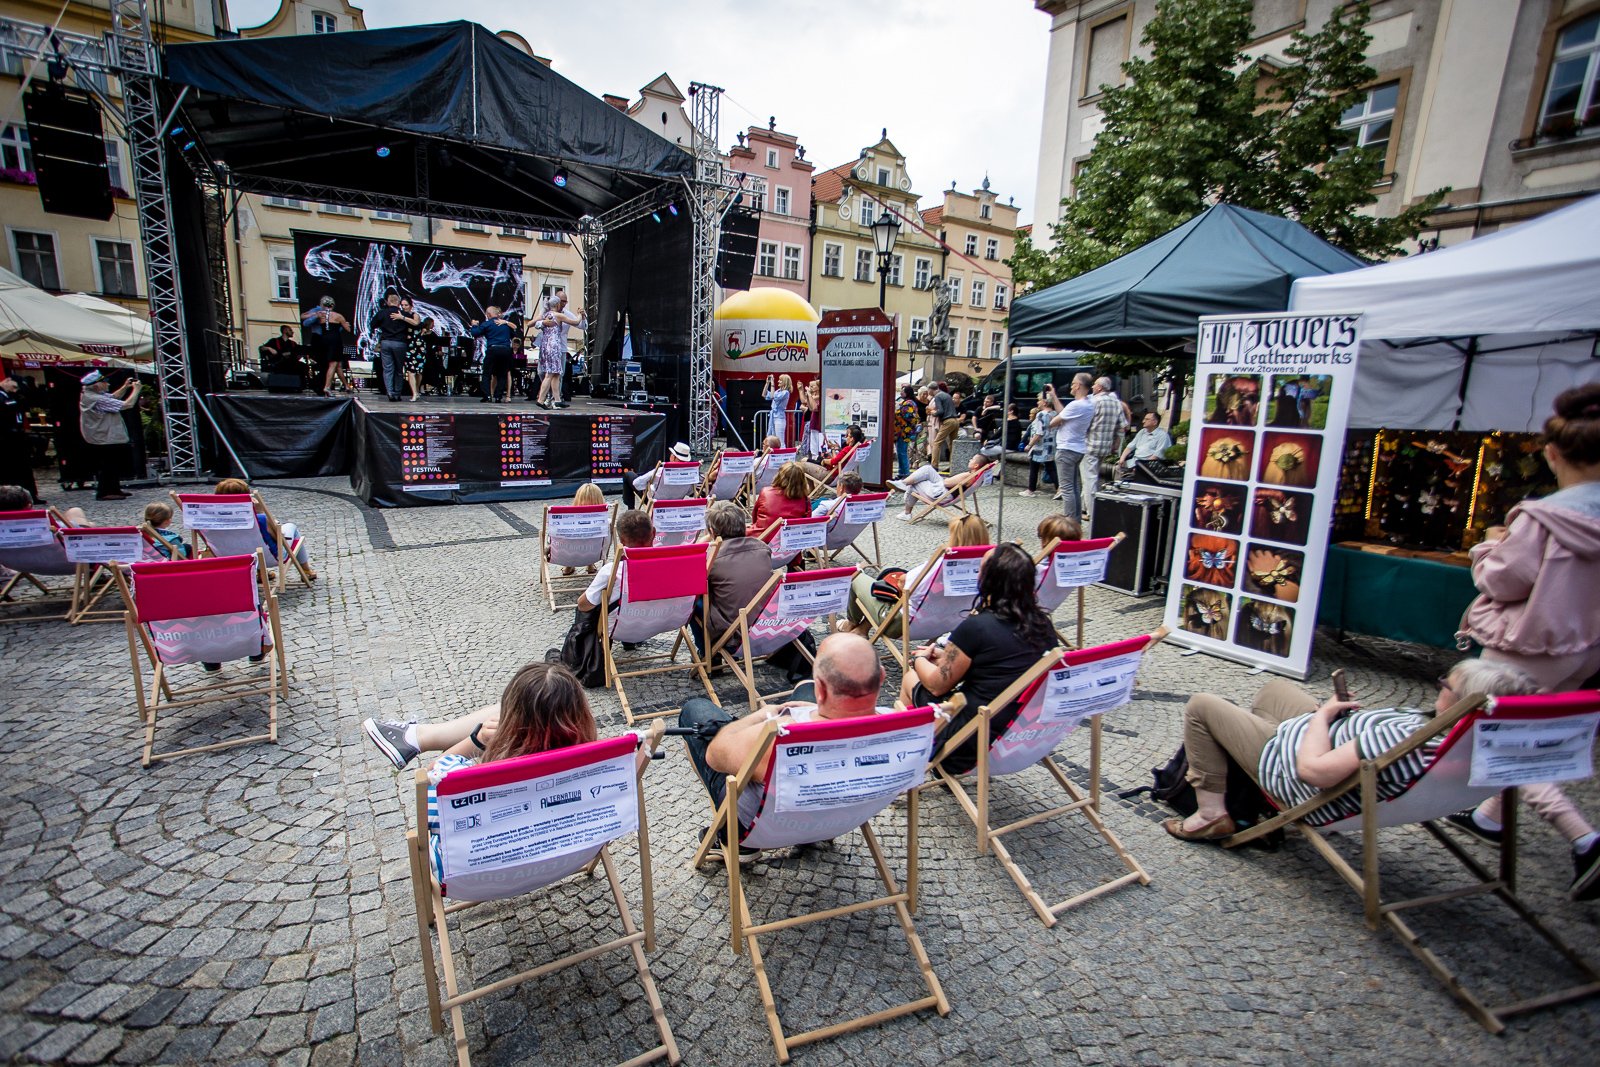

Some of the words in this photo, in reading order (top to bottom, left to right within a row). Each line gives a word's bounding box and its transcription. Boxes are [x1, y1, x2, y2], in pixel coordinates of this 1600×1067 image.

[750, 330, 808, 346] JELENIA
[766, 346, 806, 362] GÓRA
[1244, 348, 1353, 364] leatherworks
[1232, 365, 1307, 374] www.2towers.pl
[540, 790, 582, 809] ALTERNATIVA
